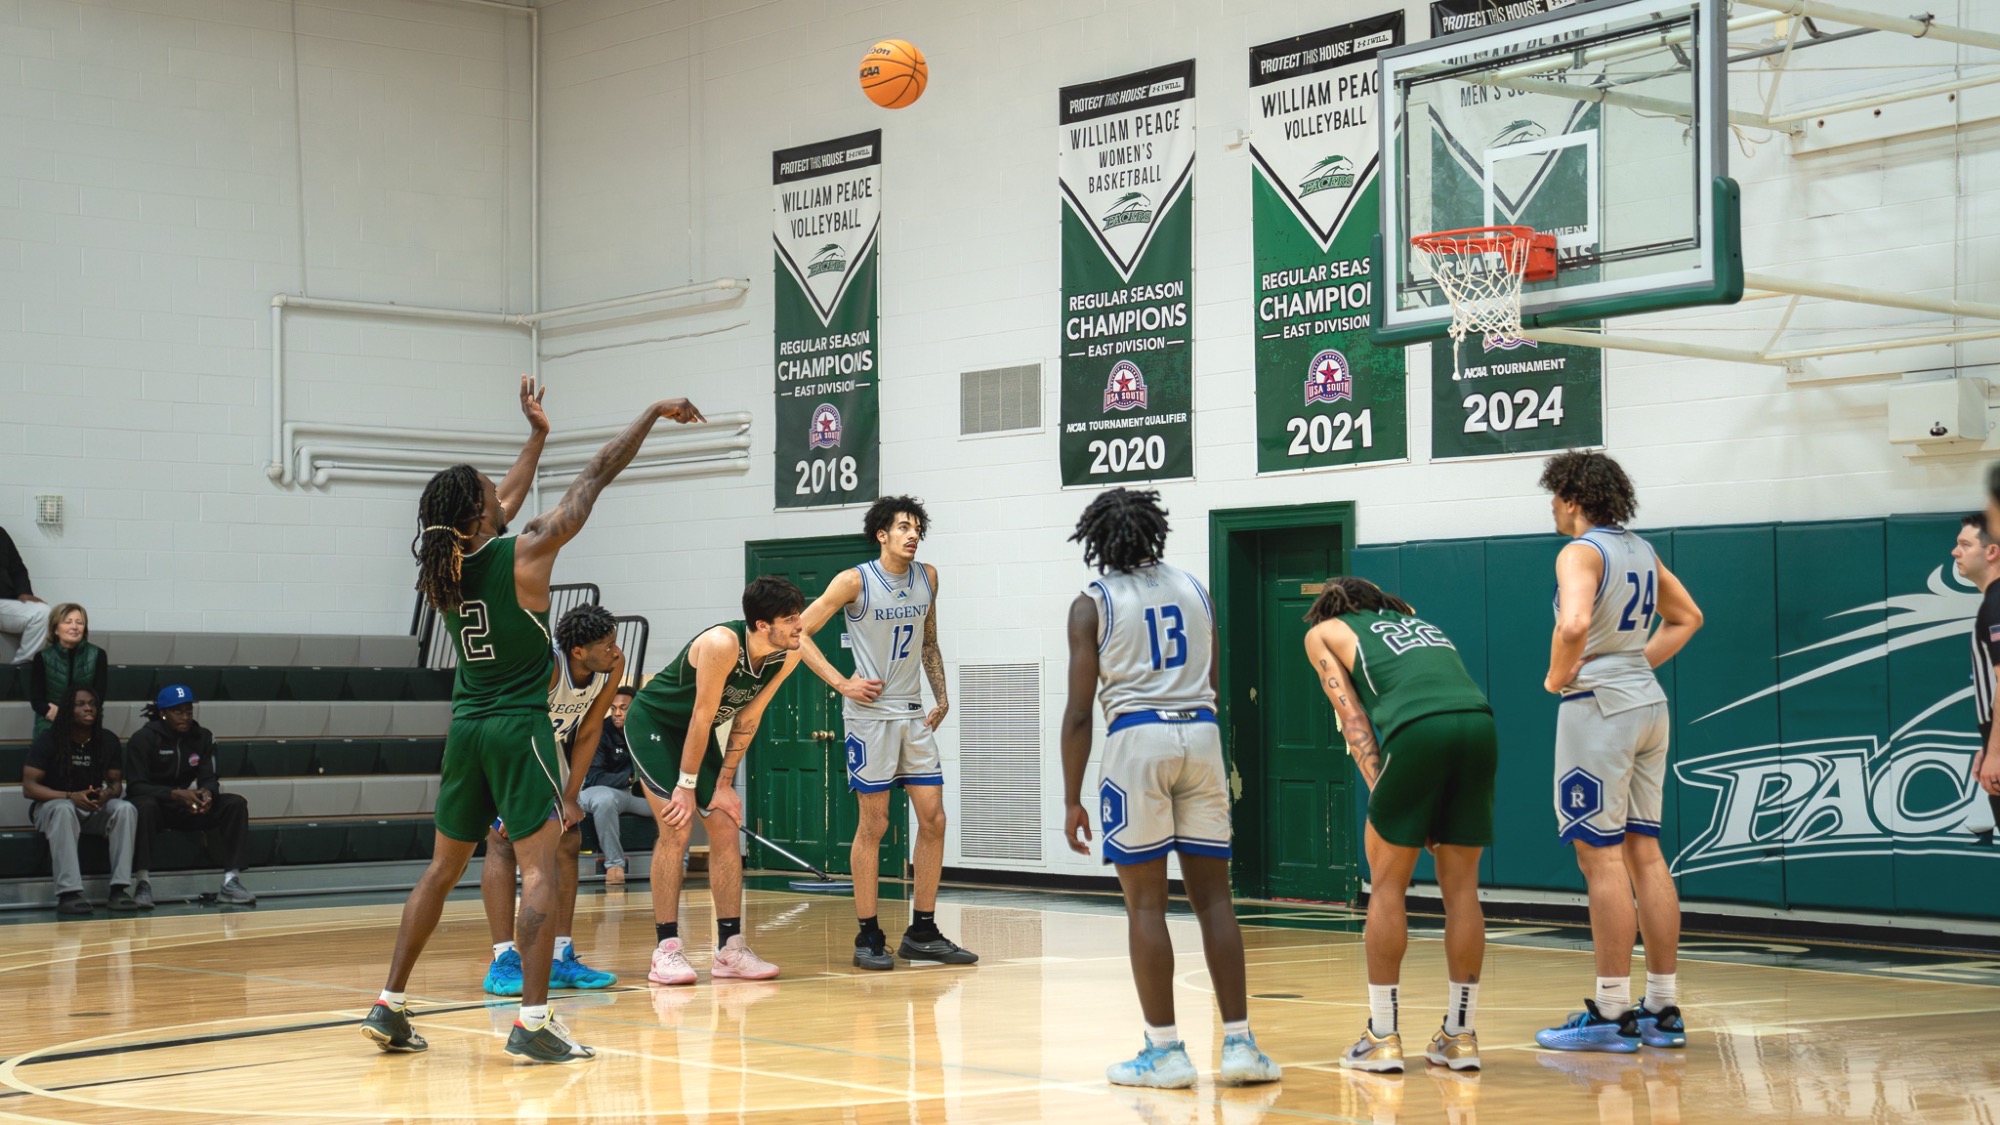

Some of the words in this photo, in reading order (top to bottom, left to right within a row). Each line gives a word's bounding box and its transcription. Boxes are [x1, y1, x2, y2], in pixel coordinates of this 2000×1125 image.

[1442, 11, 1487, 32] PROTECT
[1487, 7, 1506, 24] THIS
[1261, 53, 1302, 75] PROTECT
[1302, 48, 1318, 66] THIS
[1069, 95, 1105, 114] PROTECT
[1104, 91, 1120, 107] THIS
[1261, 80, 1332, 119] WILLIAM
[1338, 70, 1379, 102] PEAC
[1070, 118, 1129, 150] WILLIAM
[1136, 108, 1181, 139] PEACE
[1284, 105, 1367, 141] VOLLEYBALL
[780, 159, 809, 175] PROTECT
[810, 156, 822, 170] THIS
[1099, 142, 1153, 169] WOMEN'S
[1088, 164, 1162, 194] BASKETBALL
[782, 185, 832, 214] WILLIAM
[837, 177, 872, 204] PEACE
[790, 208, 861, 240] VOLLEYBALL
[1262, 265, 1327, 291] REGULAR
[1330, 257, 1370, 281] SEAS
[1069, 289, 1128, 311] REGULAR
[1130, 280, 1184, 303] SEASON
[1259, 281, 1371, 322] CHAMPIO
[1066, 303, 1187, 341] CHAMPIONS
[1283, 323, 1311, 339] EAST
[1315, 314, 1370, 335] DIVISION
[780, 337, 828, 356] REGULAR
[829, 330, 870, 349] SEASON
[1088, 343, 1114, 357] EAST
[1116, 337, 1165, 354] DIVISION
[777, 350, 873, 381] CHAMPIONS
[1463, 367, 1488, 379] NCAA
[1491, 358, 1566, 377] TOURNAMENT
[794, 385, 816, 397] EAST
[817, 380, 856, 395] DIVISION
[1106, 392, 1119, 404] USA
[1121, 391, 1145, 402] SOUTH
[1308, 385, 1324, 398] USA
[1326, 382, 1349, 393] SOUTH
[1066, 423, 1087, 434] NCAA
[1089, 417, 1145, 431] TOURNAMENT
[1145, 413, 1187, 425] QUALIFIER
[1462, 385, 1565, 434] 2024
[1286, 408, 1373, 456] 2021
[1088, 435, 1166, 475] 2020
[795, 455, 859, 495] 2018
[874, 603, 929, 621] REGENT
[1615, 569, 1655, 632] 24
[459, 600, 496, 661] 2
[891, 623, 914, 661] 12
[1144, 604, 1188, 673] 13
[1370, 618, 1457, 655] 22
[176, 687, 185, 698] B
[549, 699, 594, 714] REGE
[847, 751, 856, 764] R
[1103, 805, 1113, 823] R
[1570, 791, 1588, 809] R
